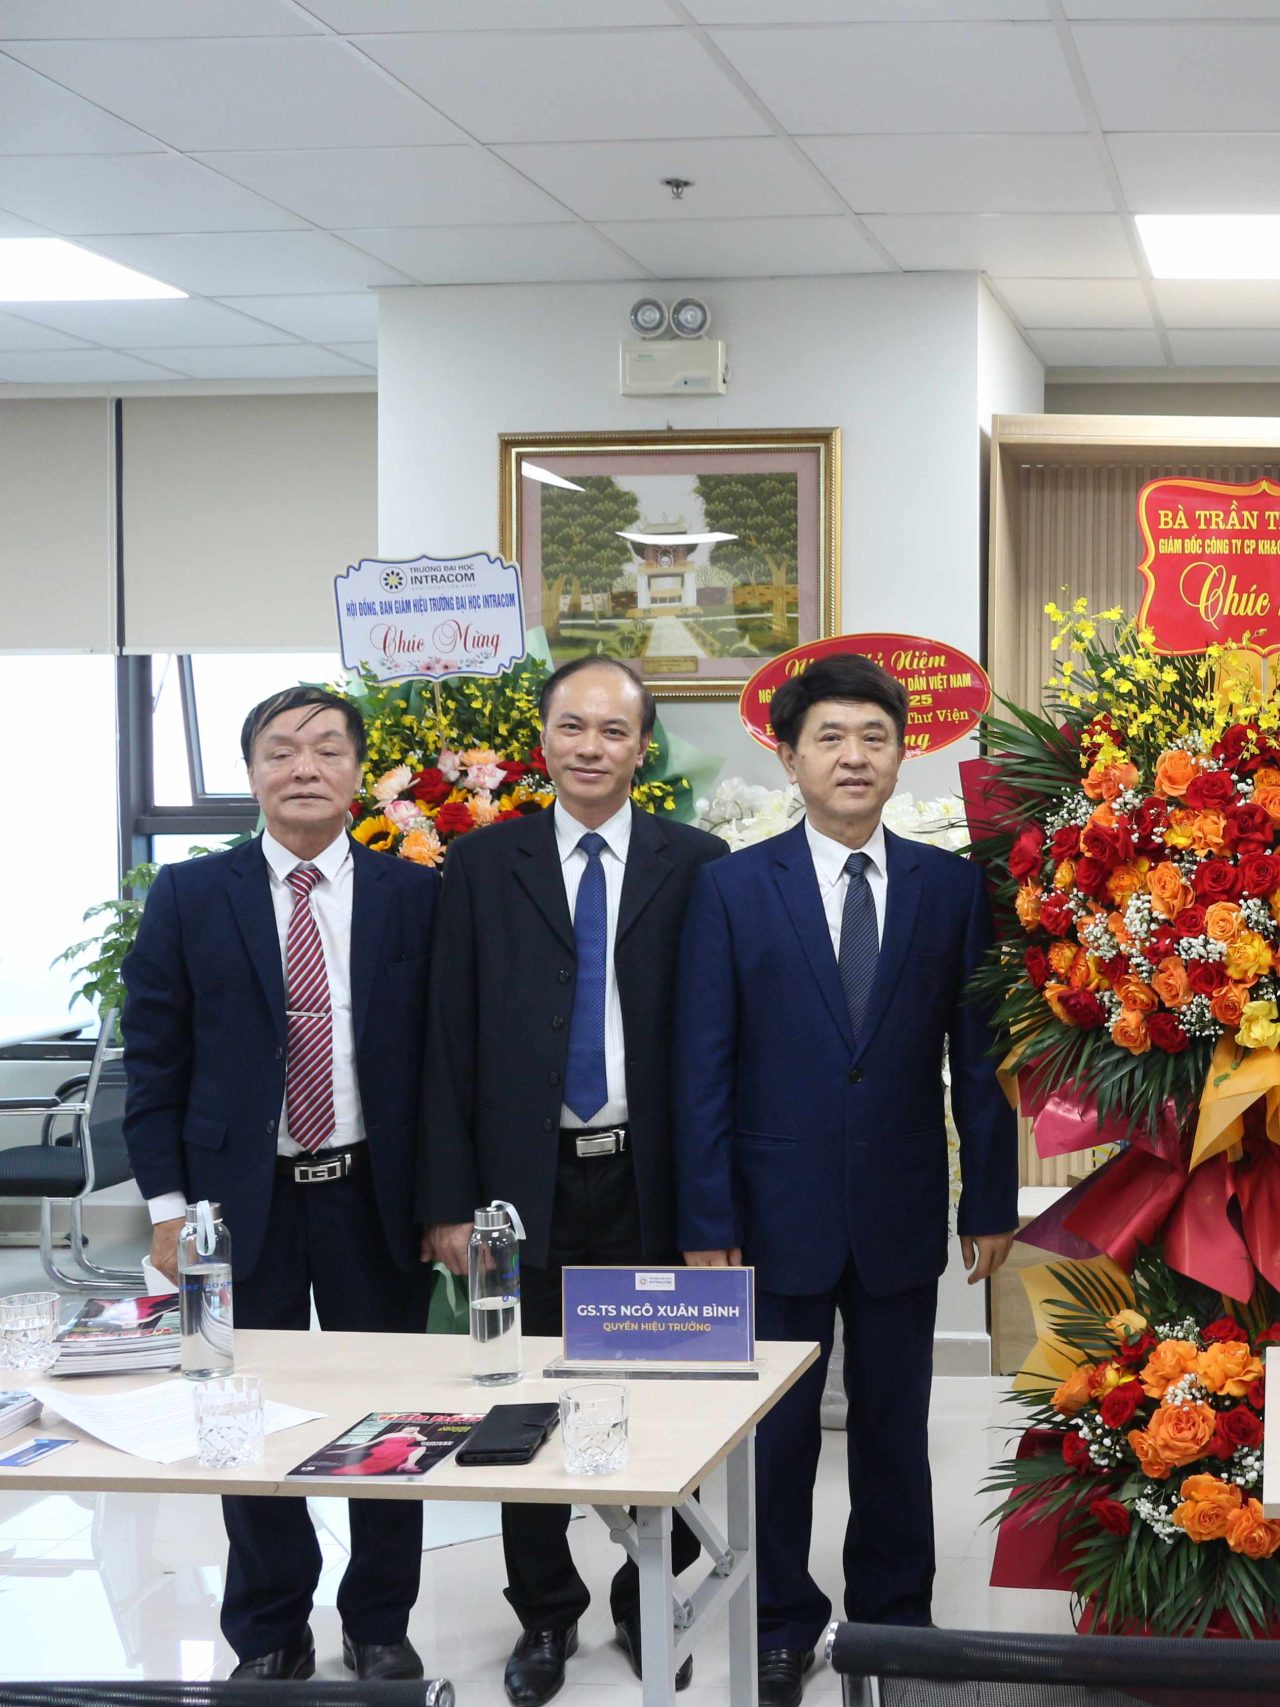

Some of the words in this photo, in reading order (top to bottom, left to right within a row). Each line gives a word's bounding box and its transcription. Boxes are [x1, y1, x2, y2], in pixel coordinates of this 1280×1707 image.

[1158, 504, 1189, 530] BÀ
[1195, 500, 1259, 530] TRẦN
[1159, 535, 1182, 554] GIÁM
[1184, 533, 1203, 554] ĐỐC
[1205, 535, 1229, 555] CÔNG
[1231, 539, 1242, 555] TY
[1244, 539, 1256, 555] CP
[410, 572, 475, 585] INTRACOM
[380, 600, 393, 615] BAN
[468, 594, 481, 612] HỌC
[482, 592, 516, 609] INTRACOM
[1179, 561, 1271, 631] Chúc
[370, 623, 425, 663] Chúc
[432, 619, 501, 658] Mừng
[891, 650, 948, 674] Niệm
[907, 674, 926, 692] DÂN
[929, 672, 948, 692] VIỆT
[949, 673, 972, 688] NAM
[936, 708, 970, 724] Viện
[577, 1304, 617, 1317] GS.TS
[620, 1302, 653, 1317] NGÔ
[657, 1302, 699, 1317] XUÂN
[702, 1303, 740, 1317] BÌNH
[641, 1321, 665, 1333] HIỆU
